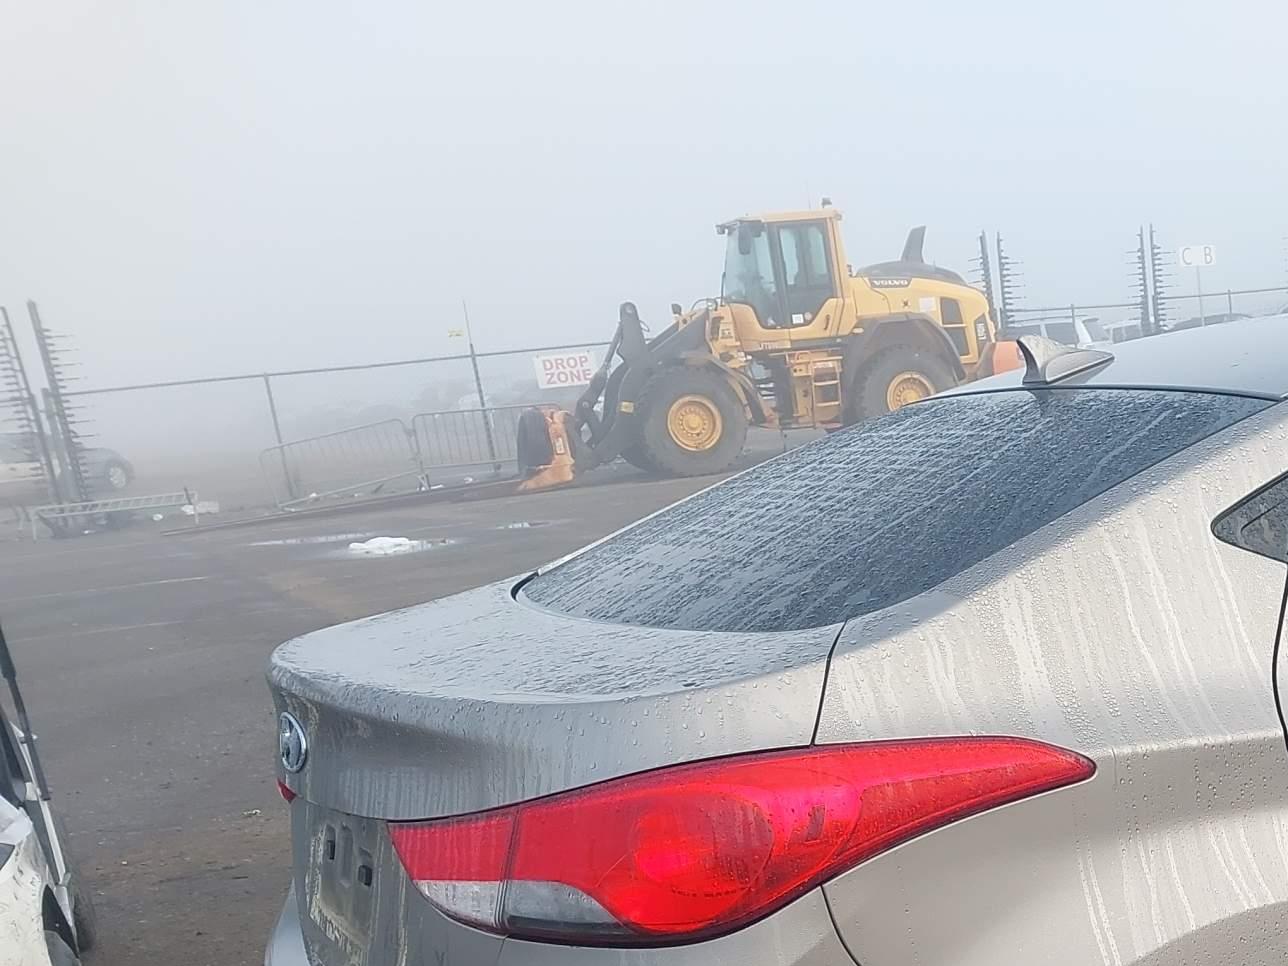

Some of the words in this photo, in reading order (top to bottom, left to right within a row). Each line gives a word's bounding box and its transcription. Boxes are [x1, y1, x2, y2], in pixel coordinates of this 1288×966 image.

[1182, 247, 1192, 265] C
[1203, 246, 1213, 264] B
[542, 356, 588, 370] DROP
[545, 369, 591, 384] ZONE
